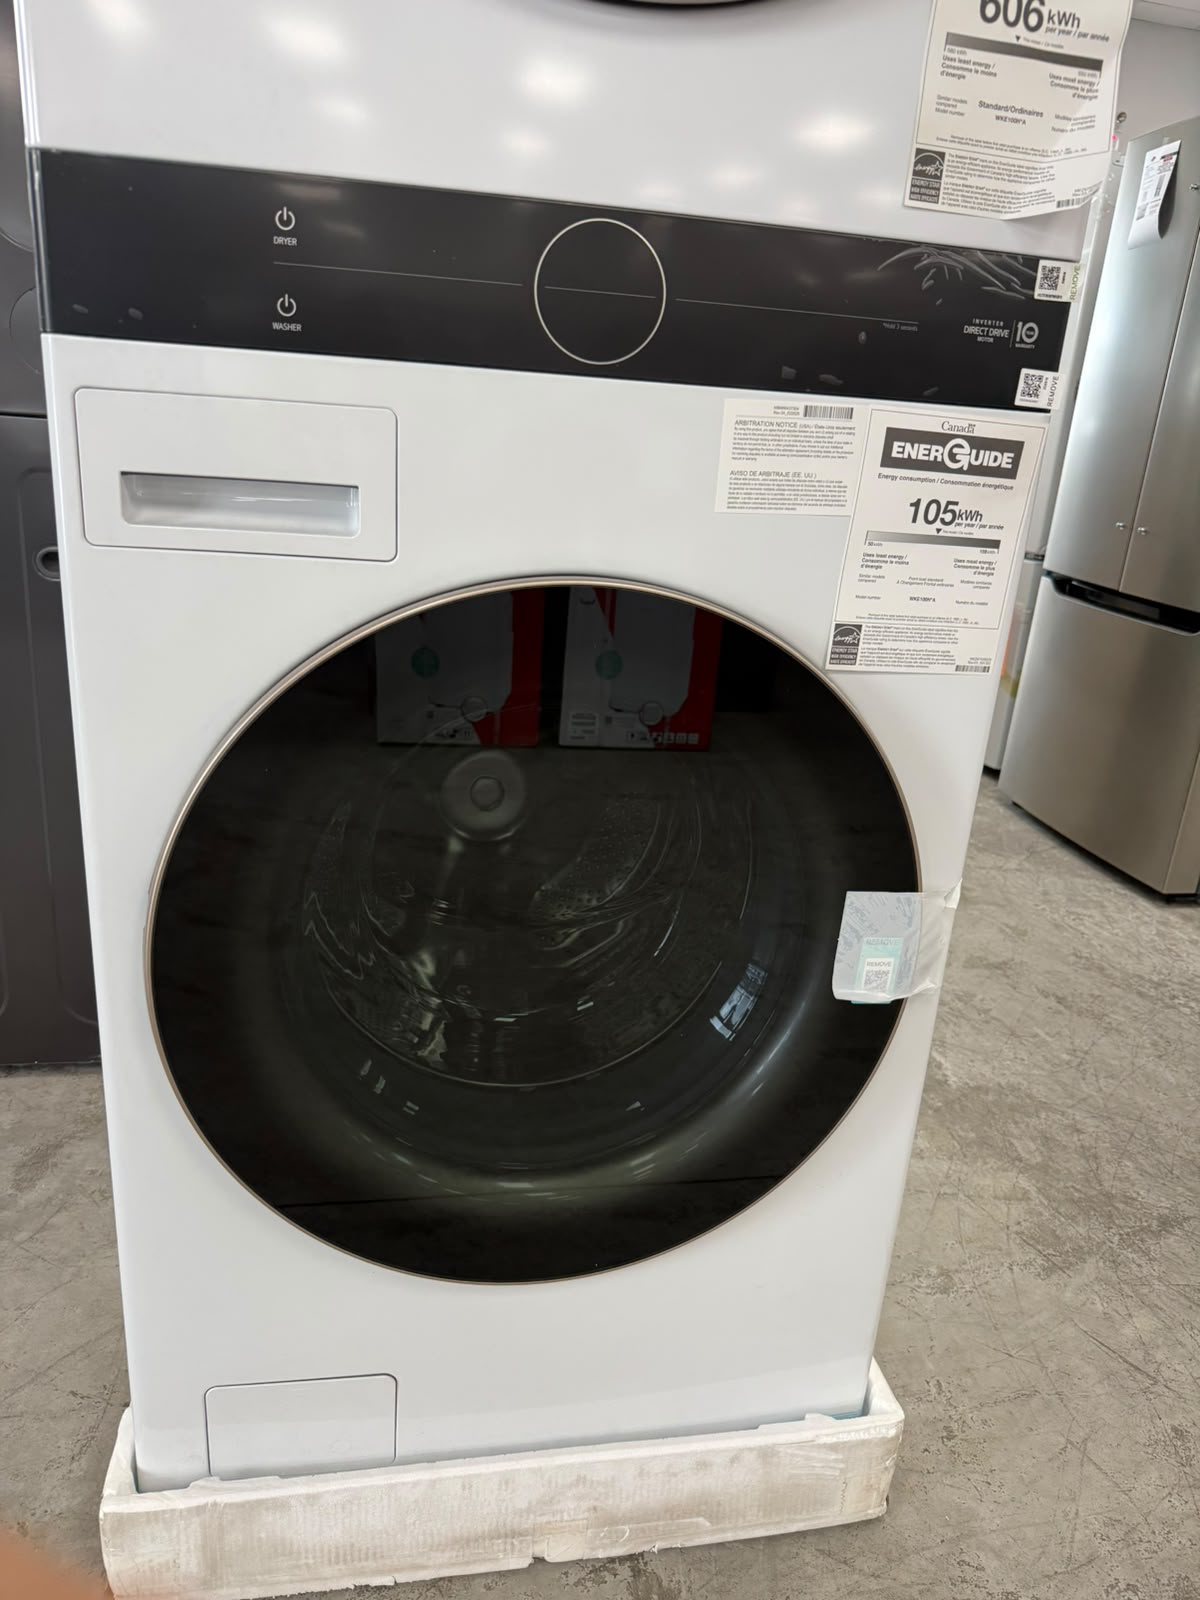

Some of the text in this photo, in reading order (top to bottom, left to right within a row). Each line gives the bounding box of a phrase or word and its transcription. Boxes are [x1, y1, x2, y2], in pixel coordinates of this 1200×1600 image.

[979, 0, 1081, 33] 606 kWh
[1045, 25, 1058, 34] per
[1058, 28, 1074, 37] year
[273, 236, 298, 247] DRYER
[1069, 264, 1081, 301] REMOVE
[272, 322, 302, 332] WASHER
[973, 317, 1004, 327] INVERTER
[963, 325, 1010, 338] DIRECT DRIVE
[1016, 321, 1040, 344] 10
[1046, 375, 1060, 408] REMOVE
[775, 421, 798, 429] NOTICE
[941, 421, 976, 434] Canada
[877, 472, 899, 481] Energy
[899, 475, 937, 484] consumption
[940, 478, 982, 488] Consommation
[909, 498, 983, 526] 105 kWh
[954, 521, 964, 529] per
[964, 522, 976, 530] year
[978, 523, 988, 531] par
